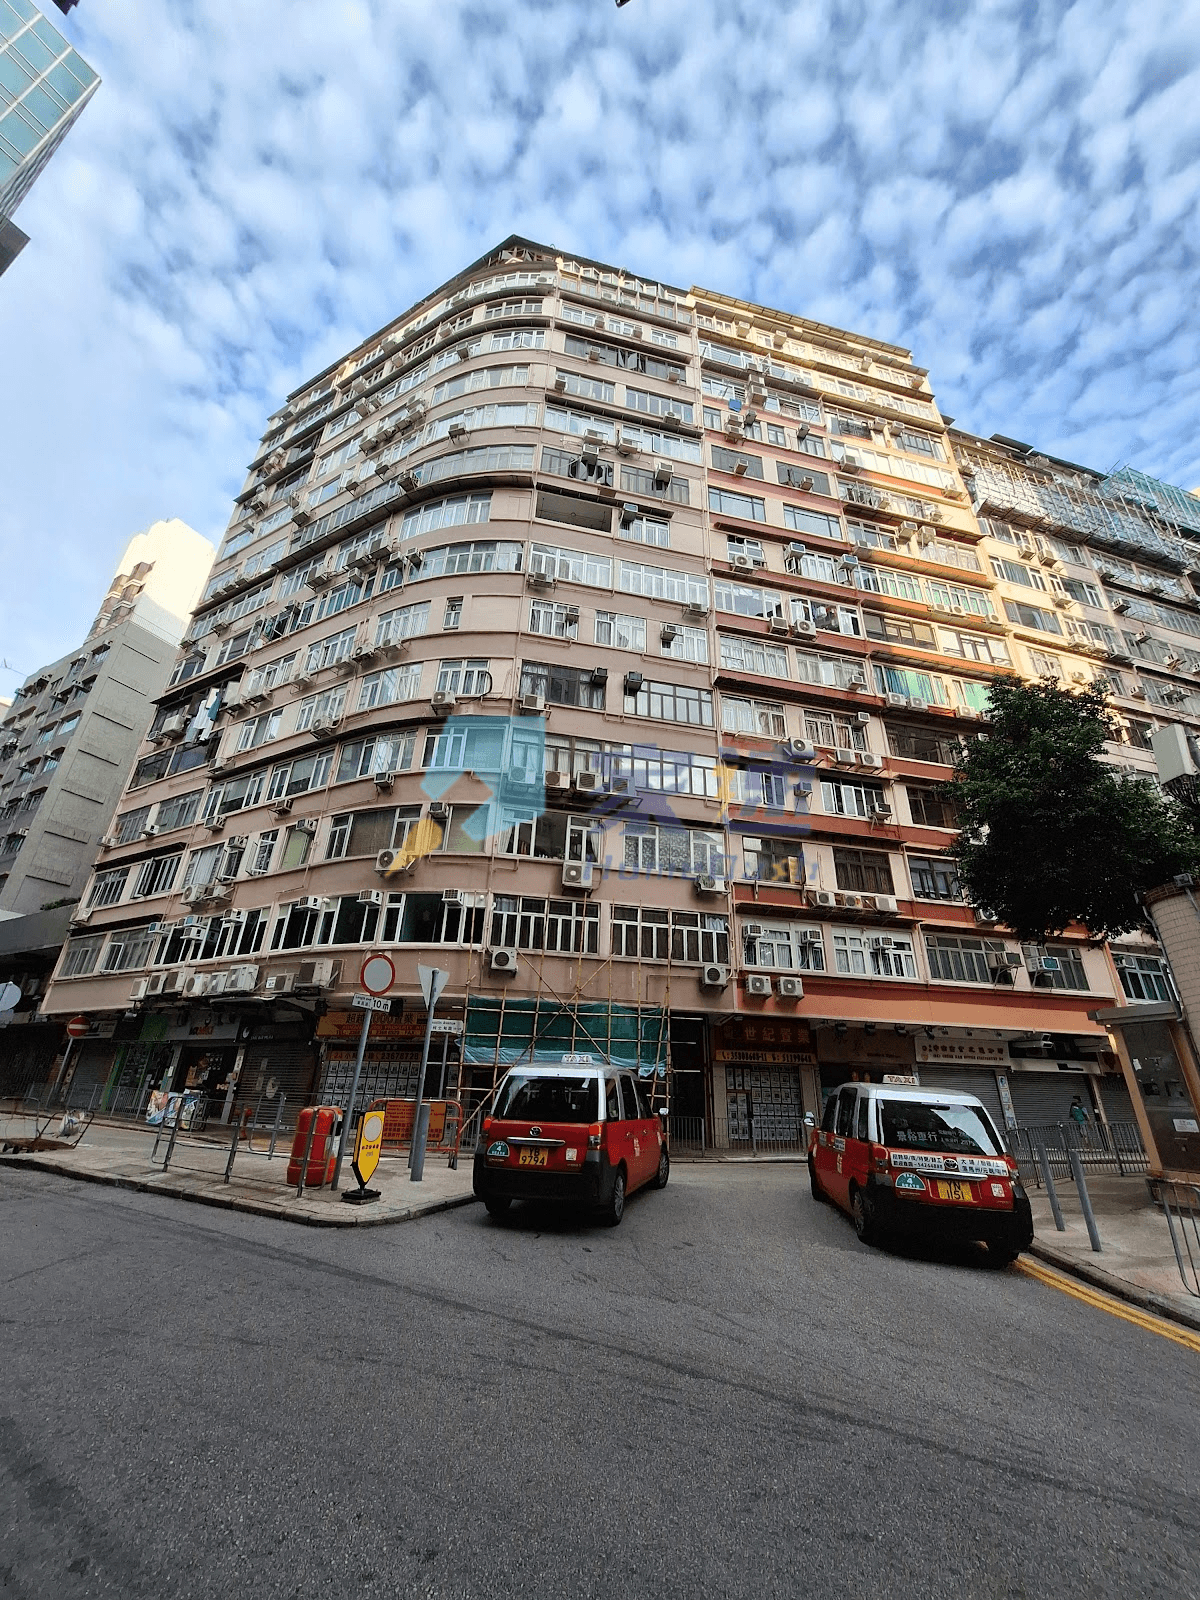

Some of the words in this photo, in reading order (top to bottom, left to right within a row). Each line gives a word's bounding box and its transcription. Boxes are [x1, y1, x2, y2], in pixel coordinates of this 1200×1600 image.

[373, 999, 382, 1009] 10
[744, 1026, 811, 1044] 世紀置業
[564, 1055, 589, 1063] TAXI
[887, 1076, 916, 1084] TAXI
[529, 1147, 541, 1156] YB
[521, 1155, 545, 1165] 9794
[946, 1180, 961, 1191] YN
[946, 1190, 965, 1200] 1151
